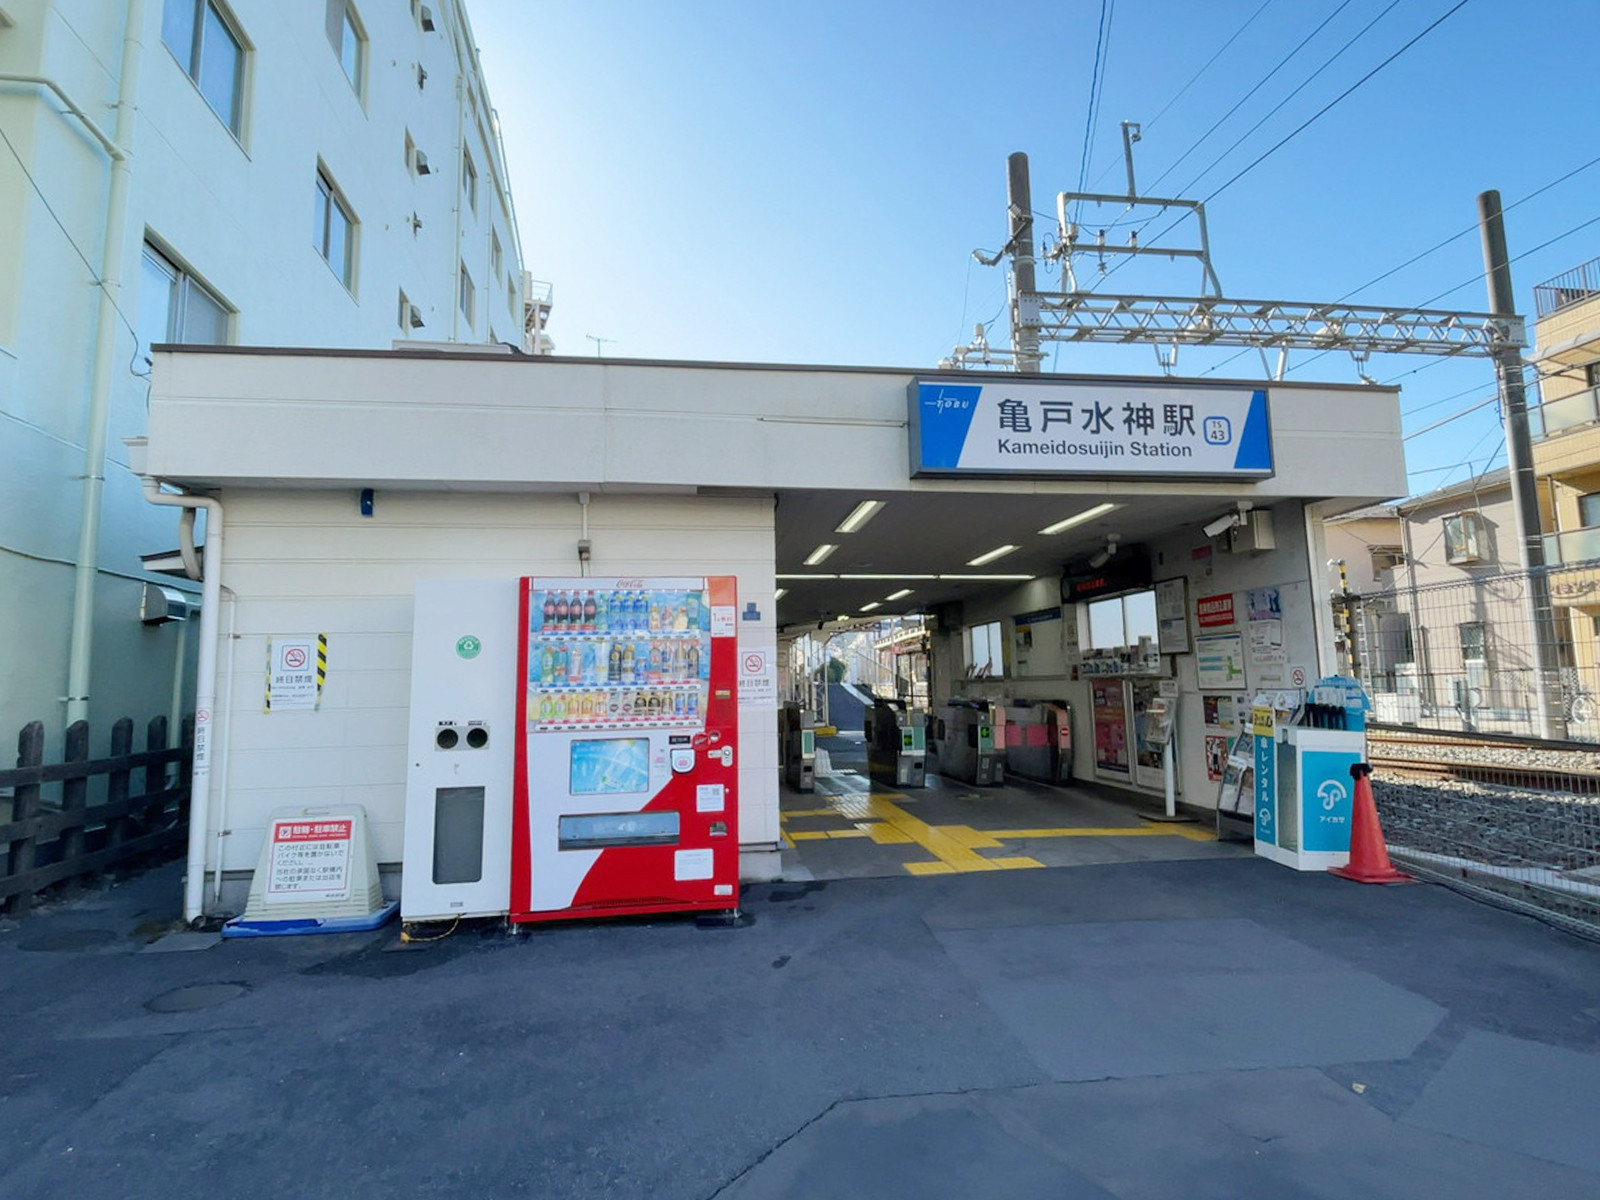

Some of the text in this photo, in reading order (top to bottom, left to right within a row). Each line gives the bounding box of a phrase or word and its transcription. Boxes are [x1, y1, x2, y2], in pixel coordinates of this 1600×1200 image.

[997, 398, 1196, 438] 亀戸水神駅
[1211, 420, 1222, 428] TS
[1211, 430, 1225, 440] 43
[998, 439, 1193, 460] Kameidosuijin Station
